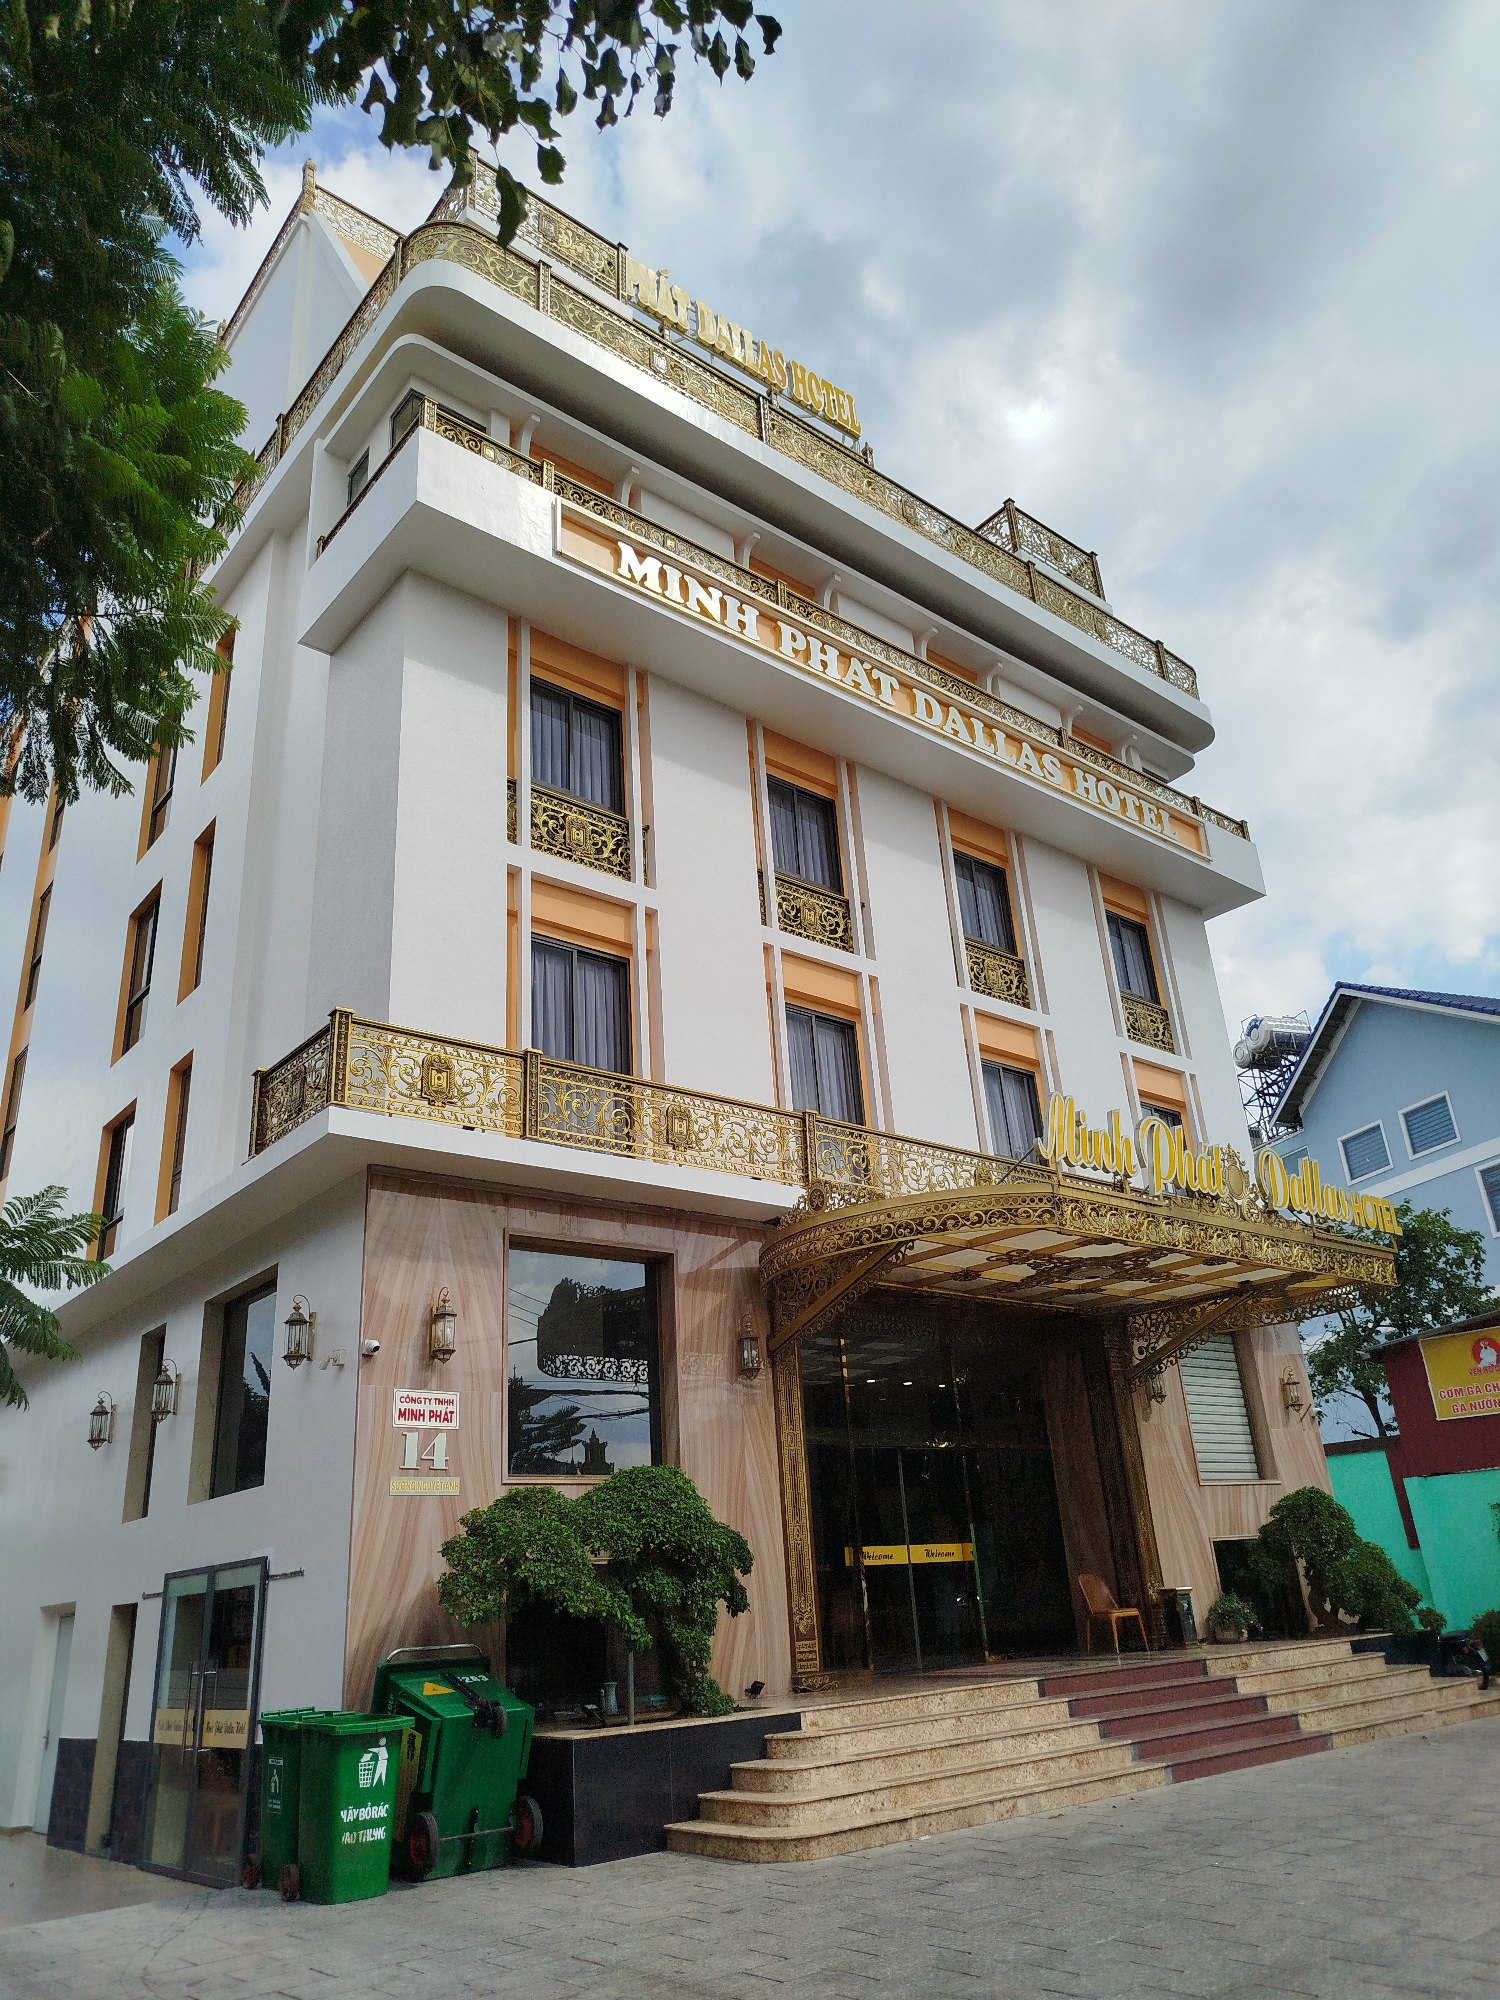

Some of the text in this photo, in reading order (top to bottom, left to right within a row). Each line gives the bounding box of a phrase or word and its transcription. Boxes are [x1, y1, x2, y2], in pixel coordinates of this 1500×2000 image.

[696, 300, 788, 392] DALLAS
[788, 359, 863, 440] HOTEL
[617, 541, 1180, 841] MINH PHÁT DALLAS HOTEL
[1034, 1091, 1403, 1235] Minh Phát Dallas HOTEL
[399, 1394, 455, 1406] CÔNG TY TNHH
[1439, 1387, 1464, 1400] CƠM
[1466, 1383, 1482, 1396] GÀ
[398, 1407, 455, 1423] MINH PHÁT
[1452, 1401, 1467, 1414] GÀ
[399, 1432, 449, 1470] 14
[371, 1802, 389, 1818] RÁC
